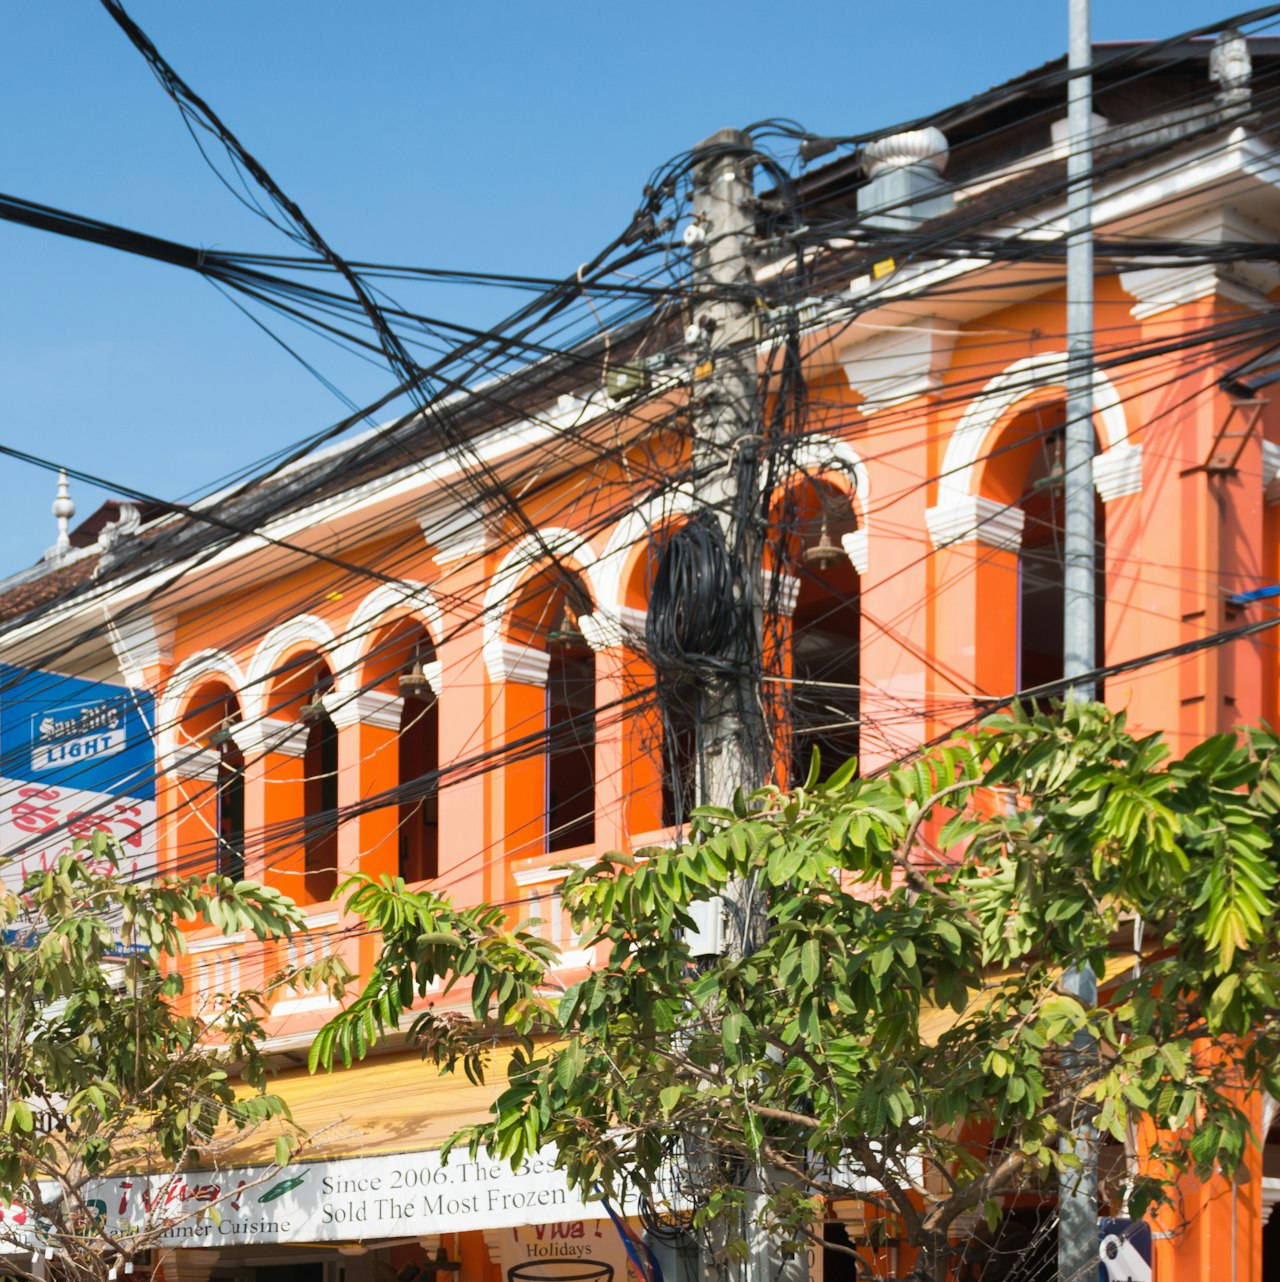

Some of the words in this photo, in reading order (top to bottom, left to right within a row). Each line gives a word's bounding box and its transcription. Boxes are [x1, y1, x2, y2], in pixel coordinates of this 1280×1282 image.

[48, 736, 113, 762] LIGHT
[321, 1169, 382, 1195] Since
[321, 1198, 367, 1224] Sold
[374, 1195, 415, 1220] The
[423, 1191, 479, 1218] Most
[487, 1185, 567, 1213] Frozen
[218, 1218, 291, 1236] Cuisine
[526, 1242, 592, 1258] Holidays
